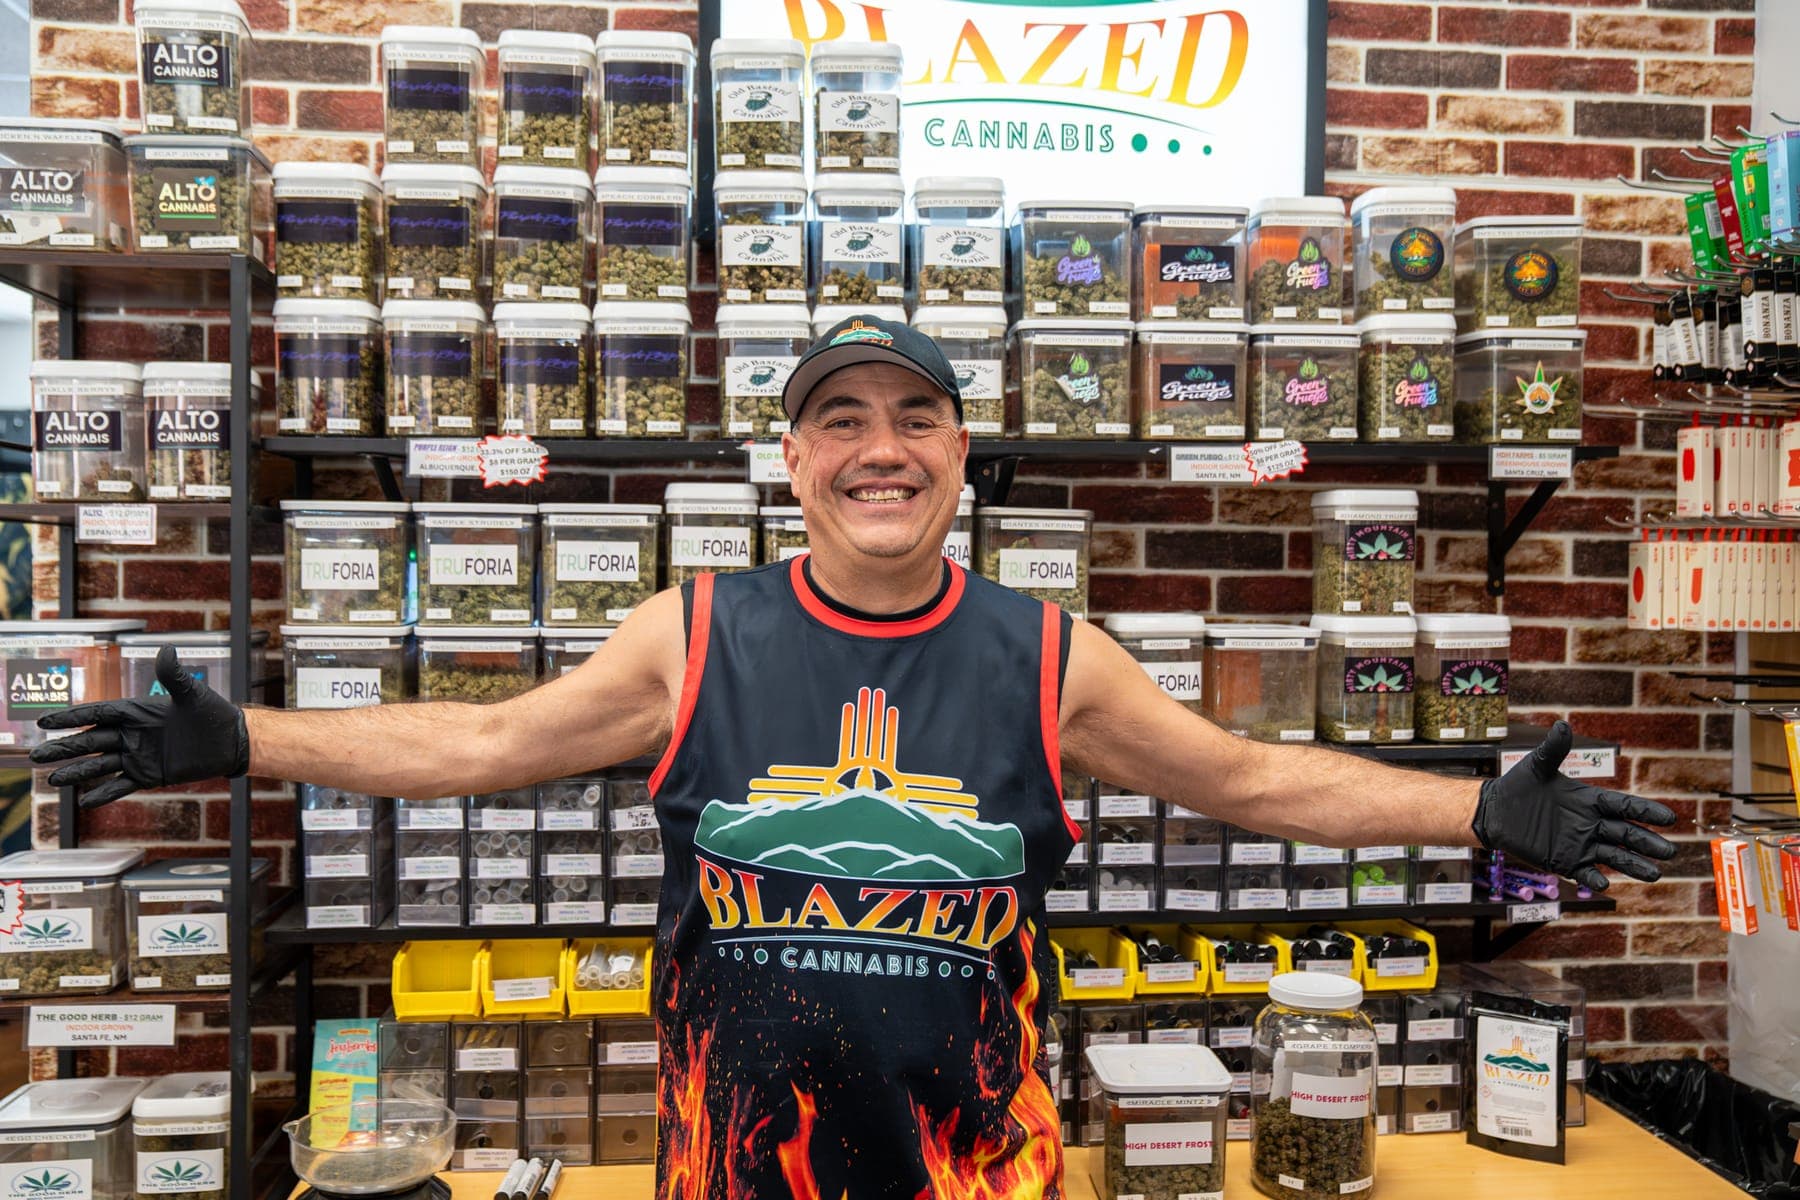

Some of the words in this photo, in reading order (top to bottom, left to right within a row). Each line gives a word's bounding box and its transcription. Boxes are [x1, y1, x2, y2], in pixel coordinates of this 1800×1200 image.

[154, 45, 218, 65] ALTO
[154, 66, 219, 79] CANNABIS
[924, 117, 1116, 154] CANNABIS
[11, 171, 73, 192] ALTO
[11, 192, 74, 205] CANNABIS
[158, 183, 216, 202] ALTO
[159, 202, 217, 213] CANNABIS
[1057, 256, 1093, 276] Green
[1162, 261, 1217, 276] Green
[1286, 262, 1320, 280] Green
[1177, 267, 1232, 283] Fuego
[1296, 271, 1328, 290] Fuego
[1761, 295, 1771, 339] BONANZA
[1782, 297, 1792, 341] BONANZA
[1162, 381, 1217, 396] Green
[1177, 387, 1232, 402] Fuego
[1285, 378, 1320, 397] Green
[1395, 380, 1429, 399] Green
[1295, 387, 1328, 406] Fuego
[1404, 389, 1437, 408] Fuego
[45, 411, 110, 432] ALTO
[157, 410, 220, 430] ALTO
[45, 432, 110, 444] CANNABIS
[157, 431, 220, 443] CANNABIS
[1264, 444, 1278, 452] OFF
[1265, 455, 1279, 464] PER
[1280, 448, 1301, 461] GRAM
[1546, 452, 1567, 460] GRAM
[517, 457, 541, 465] GRAM
[1175, 453, 1199, 461] GREEN
[1200, 453, 1223, 461] FUEGO
[1538, 460, 1568, 468] GROWN
[500, 469, 519, 477] $150
[1190, 463, 1218, 471] INDOOR
[1267, 463, 1284, 473] $125
[1284, 460, 1295, 469] OZ
[1217, 472, 1228, 480] FE,
[1355, 524, 1409, 539] MOUNTAIN
[674, 539, 749, 557] TRUFORIA
[434, 557, 513, 575] TRUFORIA
[560, 553, 637, 572] TRUFORIA
[1002, 561, 1075, 580] TRUFORIA
[304, 563, 376, 581] TRUFORIA
[1355, 657, 1409, 671] MOUNTAIN
[1451, 660, 1503, 674] MOUNTAIN
[11, 672, 69, 691] ALTO
[300, 680, 381, 699] TRUFORIA
[11, 692, 69, 703] CANNABIS
[695, 854, 1019, 952] BLAZED
[780, 946, 930, 978] CANNABIS
[36, 1013, 57, 1022] THE
[59, 1013, 89, 1022] GOOD
[91, 1013, 118, 1022] HERB
[124, 1013, 140, 1022] $12
[140, 1013, 164, 1022] GRAM
[66, 1024, 100, 1032] INDOOR
[101, 1024, 134, 1032] GROWN
[71, 1034, 98, 1042] SANTA
[98, 1034, 112, 1044] FE,
[113, 1034, 128, 1042] NM
[1484, 1063, 1551, 1087] BLAZED
[1291, 1090, 1313, 1102] HIGH
[1316, 1094, 1347, 1104] DESERT
[1150, 1142, 1182, 1150] DESERT
[1185, 1140, 1215, 1149] FROST
